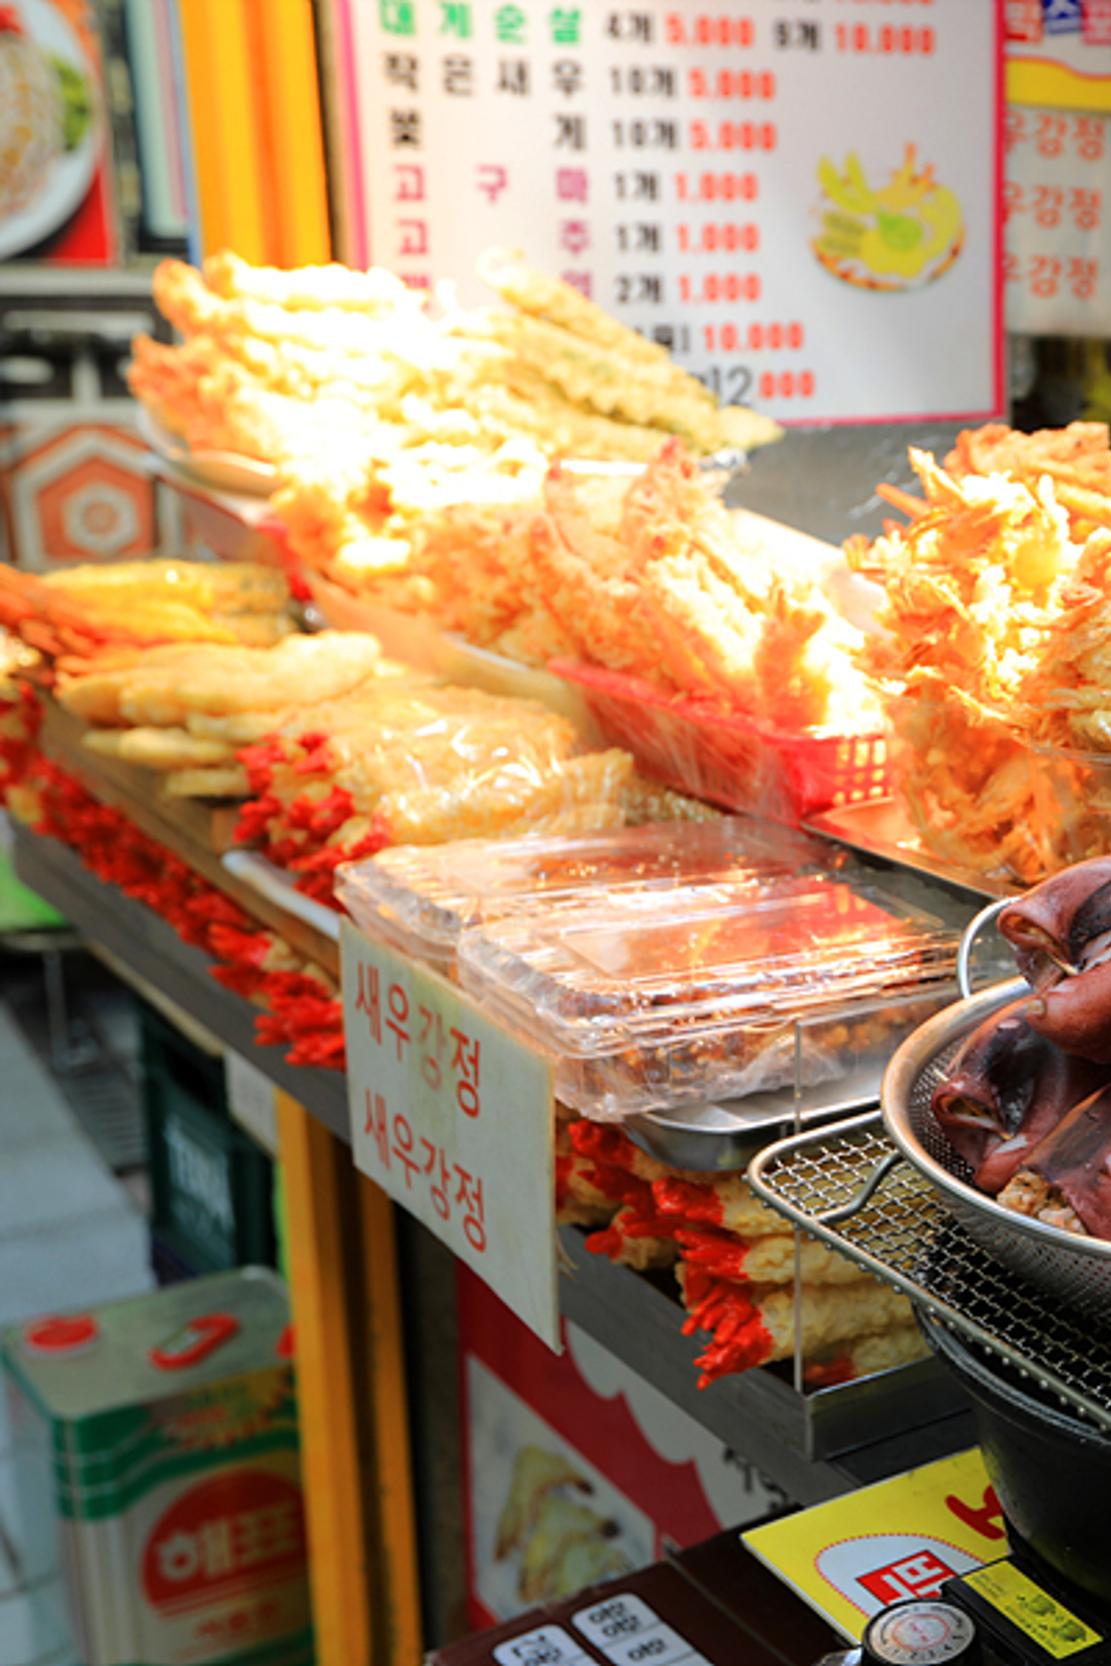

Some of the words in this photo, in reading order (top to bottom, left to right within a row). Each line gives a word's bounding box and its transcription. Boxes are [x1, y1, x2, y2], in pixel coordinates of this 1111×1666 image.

[614, 170, 658, 202] 1개
[616, 223, 660, 254] 1개
[616, 274, 663, 304] 2개
[355, 960, 481, 1119] 새우강정
[363, 1087, 488, 1254] 새우강정
